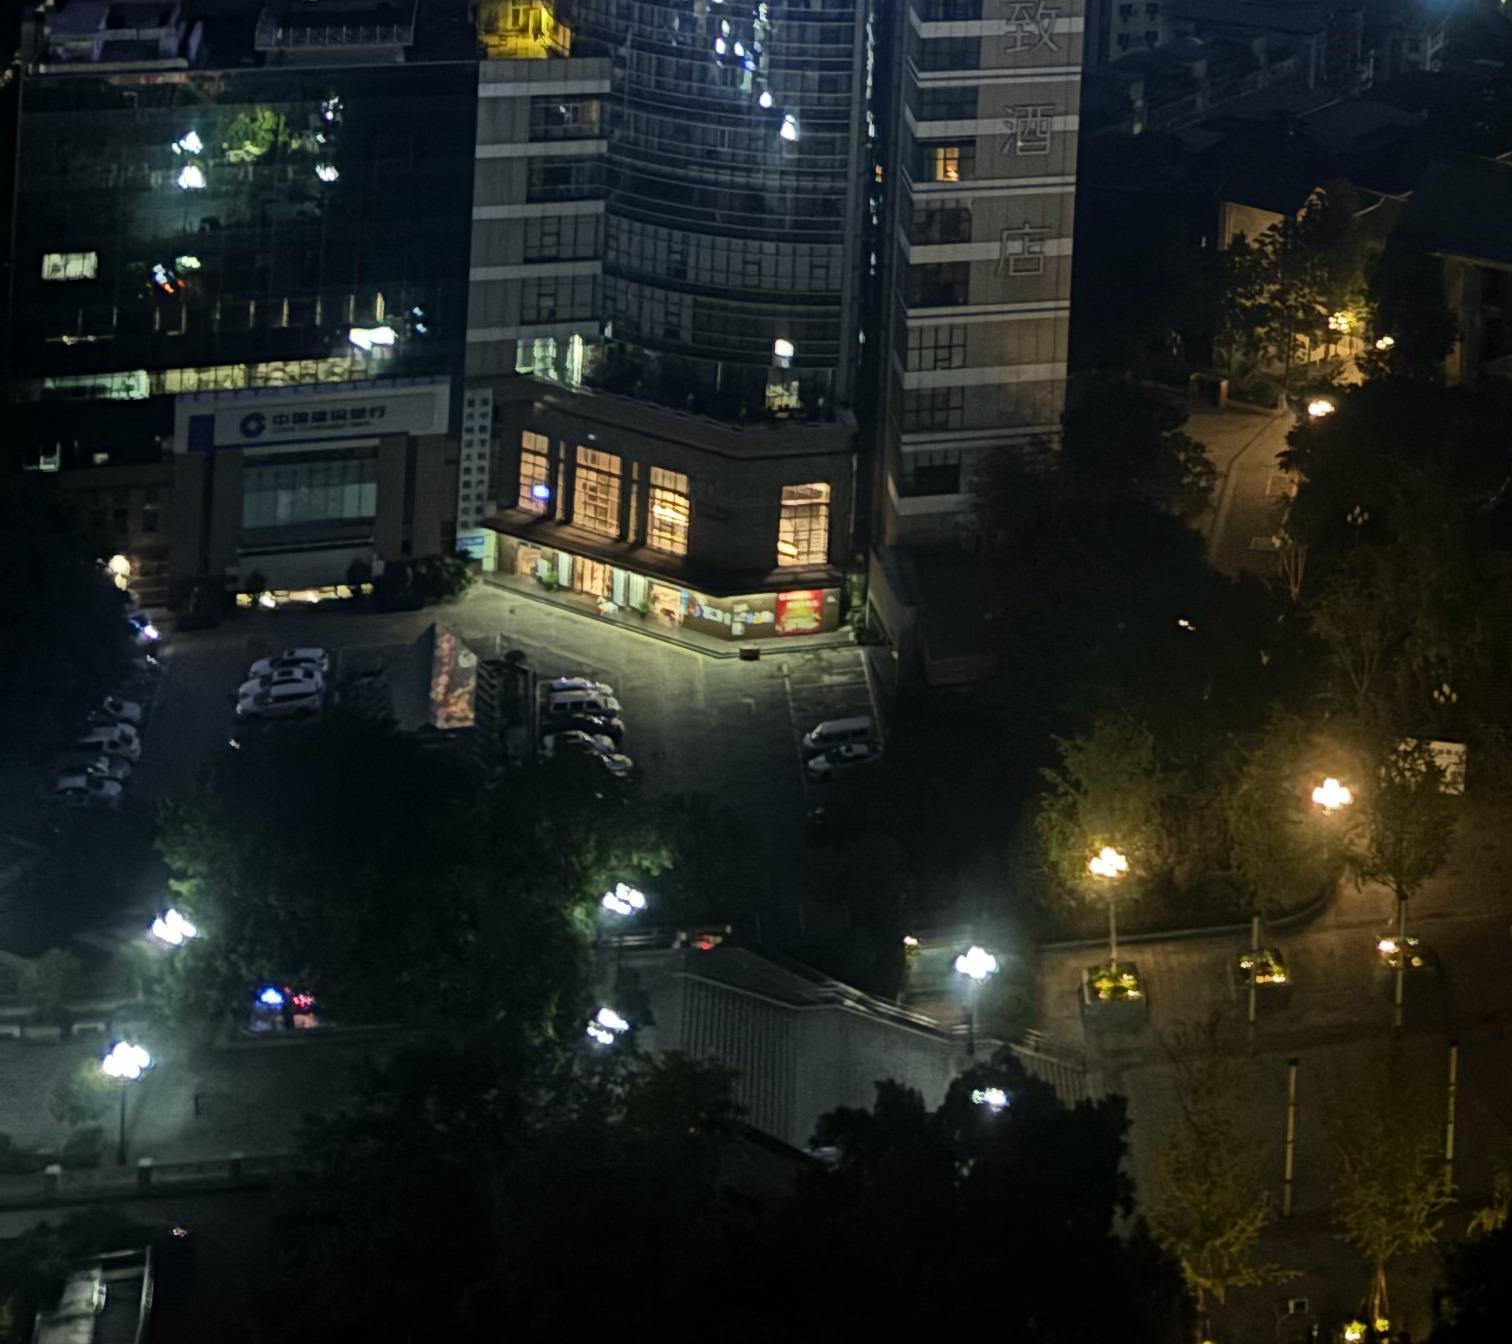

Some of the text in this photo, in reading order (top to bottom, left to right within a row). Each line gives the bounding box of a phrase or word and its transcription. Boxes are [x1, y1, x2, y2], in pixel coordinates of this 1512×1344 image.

[272, 405, 386, 425] 中国建设银行
